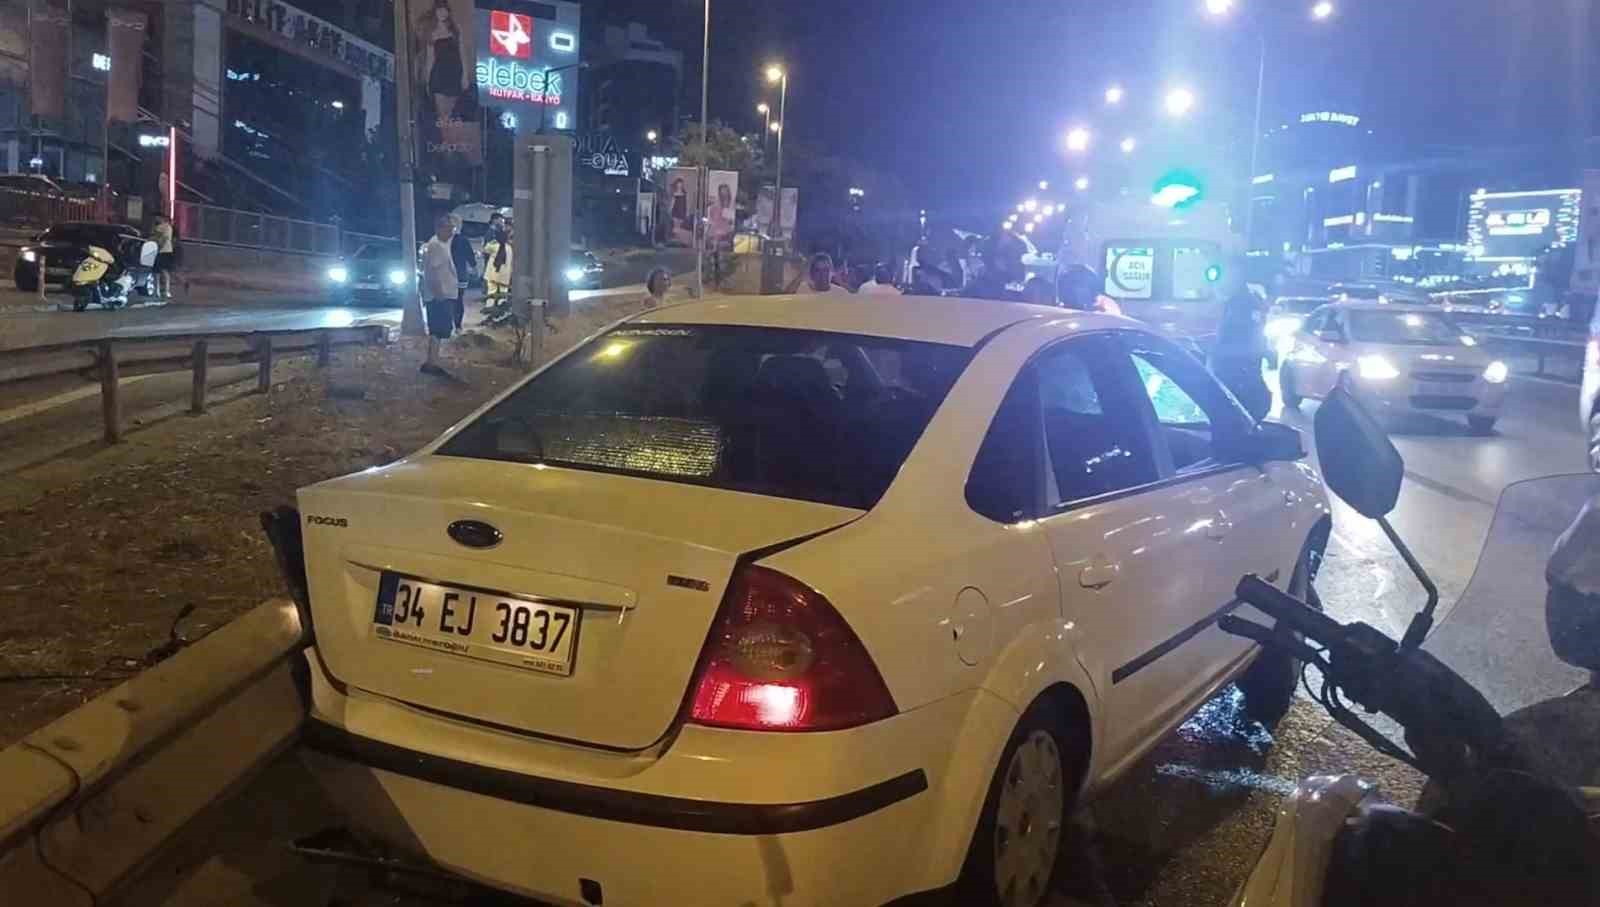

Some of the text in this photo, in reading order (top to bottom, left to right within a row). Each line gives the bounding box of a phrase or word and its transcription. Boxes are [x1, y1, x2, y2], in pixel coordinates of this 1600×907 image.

[307, 514, 348, 528] FOCUS
[395, 585, 424, 627] 34
[440, 592, 476, 636] EJ
[492, 603, 570, 653] 3837
